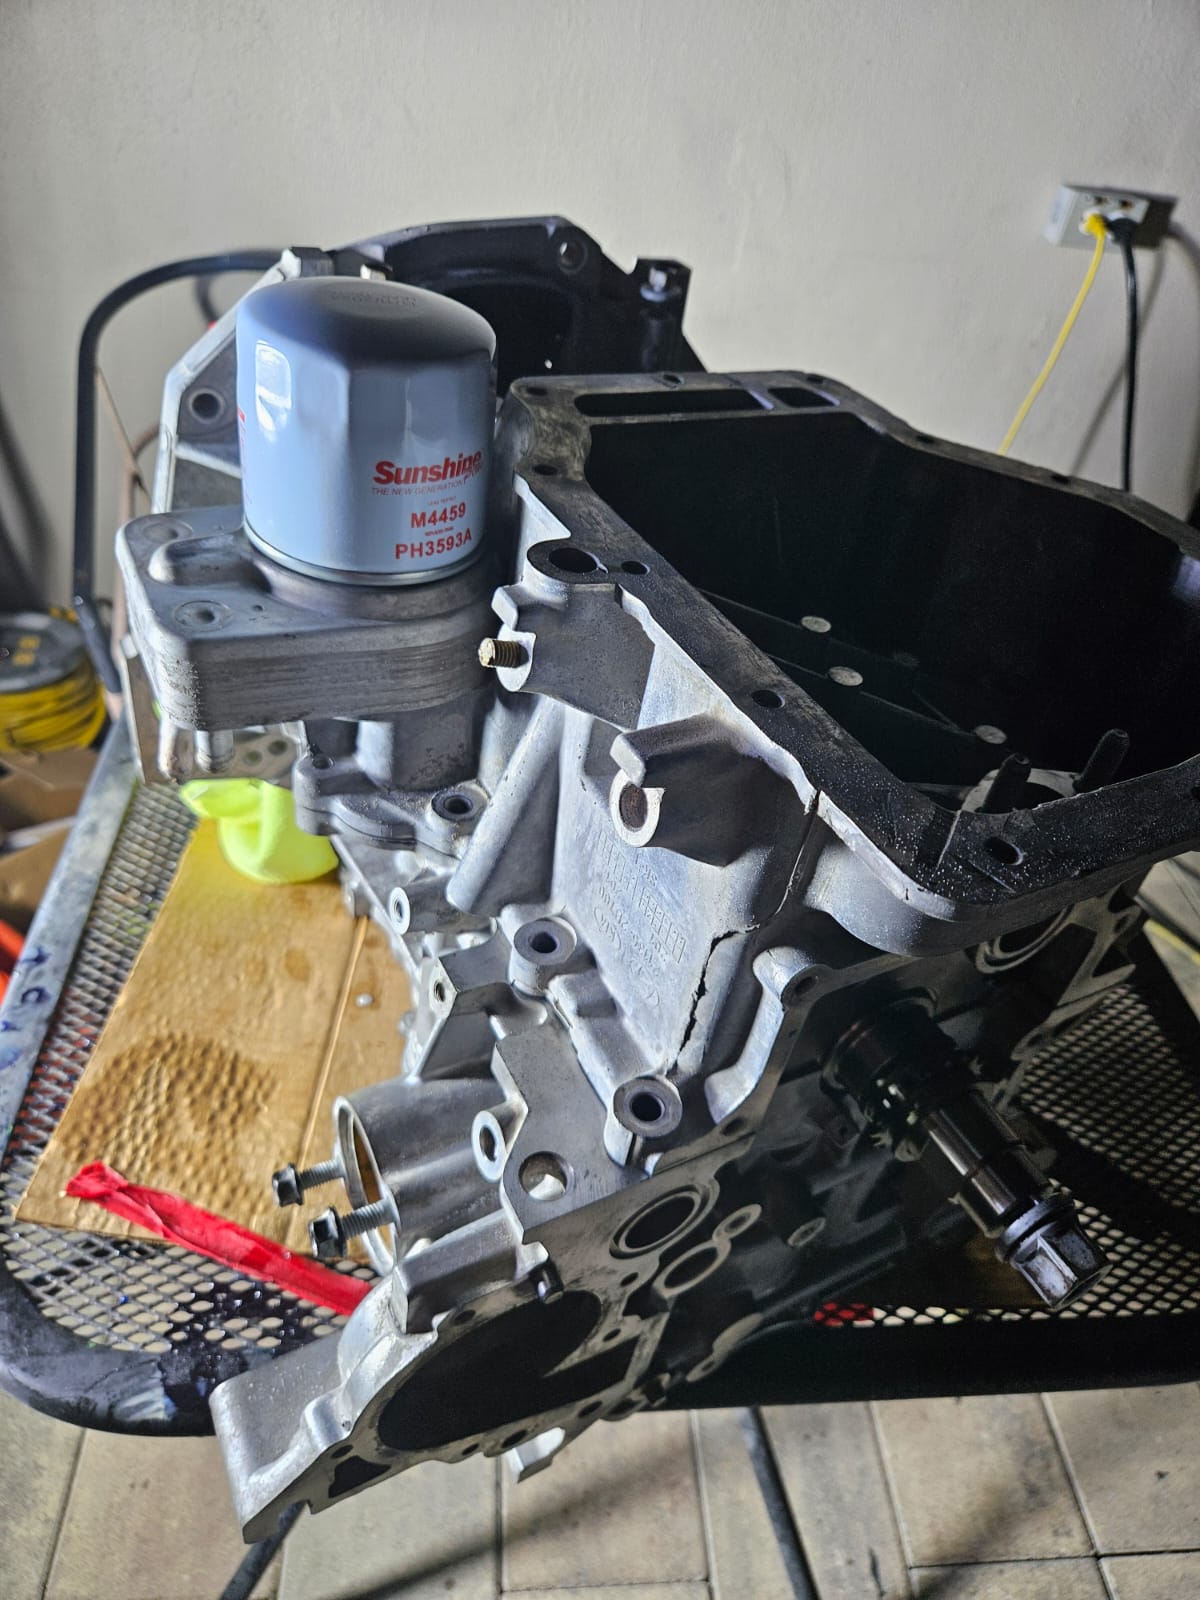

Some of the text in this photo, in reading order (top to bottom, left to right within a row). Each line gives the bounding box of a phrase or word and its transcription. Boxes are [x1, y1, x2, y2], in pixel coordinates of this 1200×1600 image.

[373, 450, 482, 485] Sunshine
[371, 487, 390, 496] THE
[391, 486, 412, 496] NEW
[411, 502, 466, 529] M4459
[395, 527, 472, 560] PH3593A
